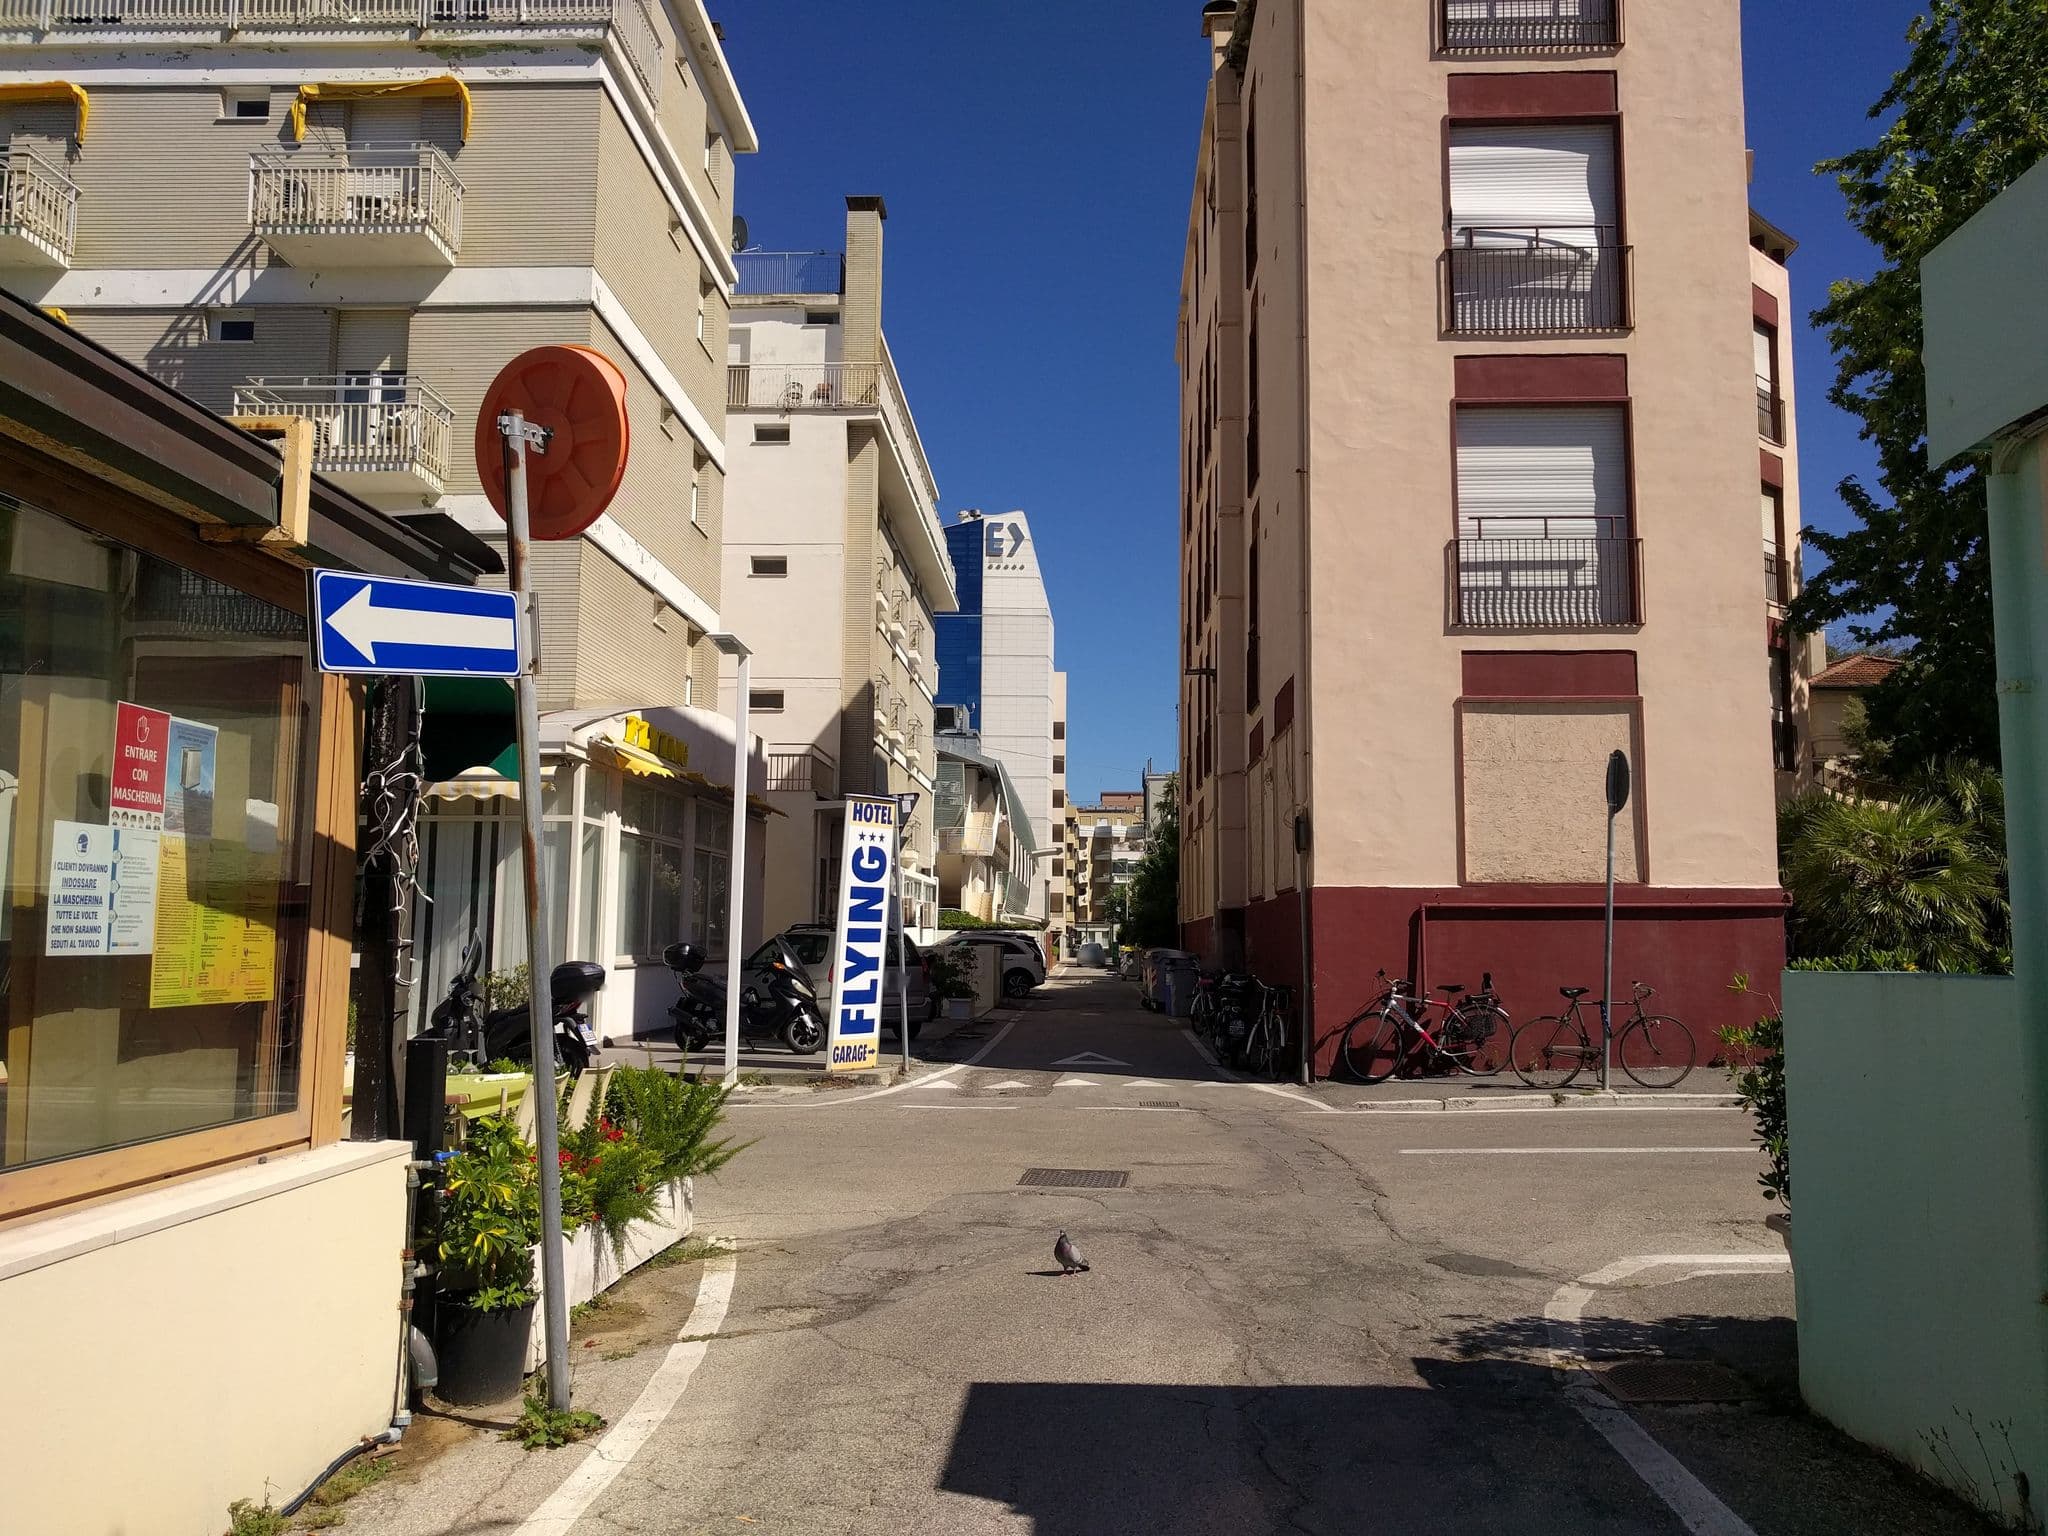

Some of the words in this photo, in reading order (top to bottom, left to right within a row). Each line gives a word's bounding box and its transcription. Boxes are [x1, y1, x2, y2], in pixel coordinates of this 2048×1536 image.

[125, 745, 158, 762] ENTRARE
[132, 768, 149, 781] CON
[113, 787, 162, 805] MASCHERINA
[852, 802, 893, 825] HOTEL
[57, 862, 78, 871] CLIENTI
[79, 863, 108, 873] DOVRANNO
[61, 877, 97, 888] INDOSSARE
[53, 894, 61, 904] LA
[62, 894, 103, 905] MASCHERINA
[56, 910, 73, 920] TUTTE
[73, 911, 80, 920] LE
[81, 911, 98, 920] VOLTE
[50, 925, 61, 934] CHE
[62, 925, 74, 934] NON
[74, 925, 102, 934] SARANNO
[50, 939, 69, 949] SEDUTI
[69, 940, 76, 948] AL
[78, 939, 100, 948] TAVOLO
[839, 845, 888, 1035] FLYING
[832, 1044, 868, 1064] GARAGE
